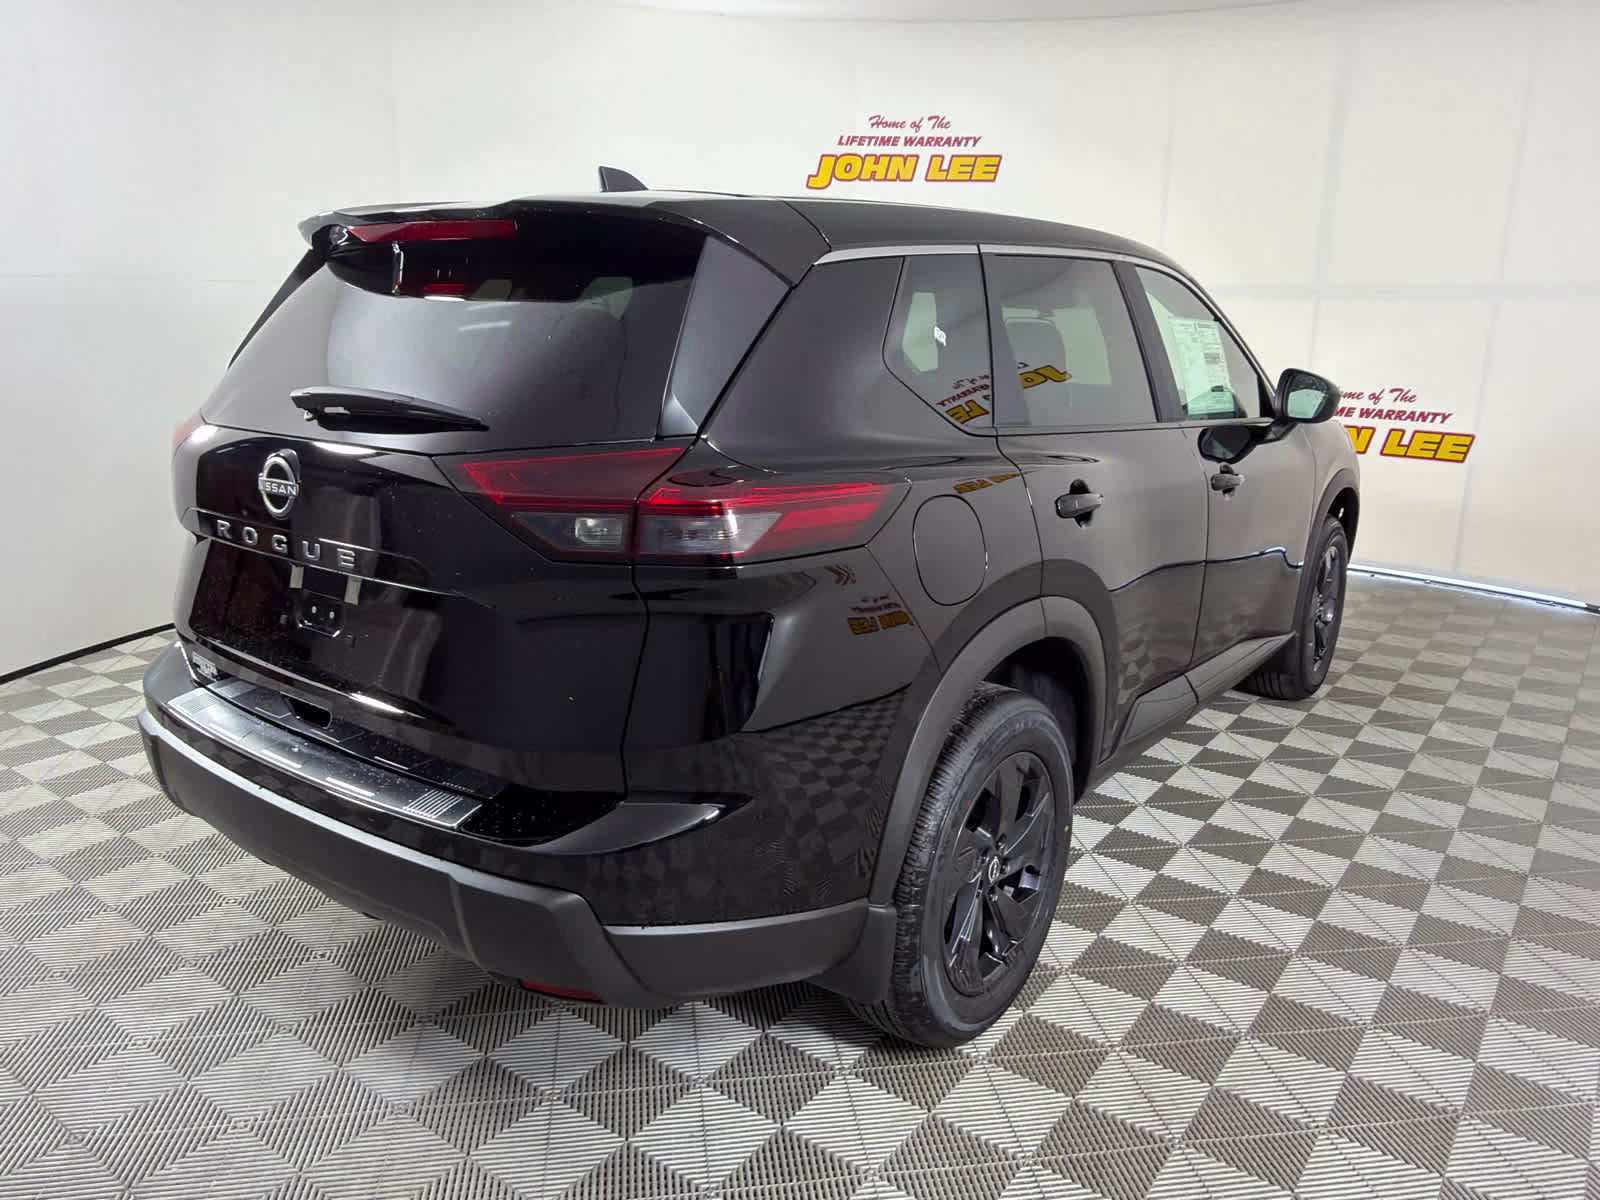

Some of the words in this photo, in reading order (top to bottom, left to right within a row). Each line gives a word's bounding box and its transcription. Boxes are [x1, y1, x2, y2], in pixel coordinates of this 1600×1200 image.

[868, 115, 907, 129] Home
[910, 117, 924, 133] of
[927, 115, 951, 129] The
[837, 135, 901, 147] LIFETIME
[902, 135, 983, 148] WARRANTY
[806, 153, 920, 190] JOHN
[924, 154, 1002, 182] LEE
[1368, 388, 1385, 405] of
[1389, 388, 1417, 403] The
[1359, 407, 1453, 424] WARRANTY
[1380, 428, 1476, 463] LEE
[216, 519, 356, 568] ROGUE
